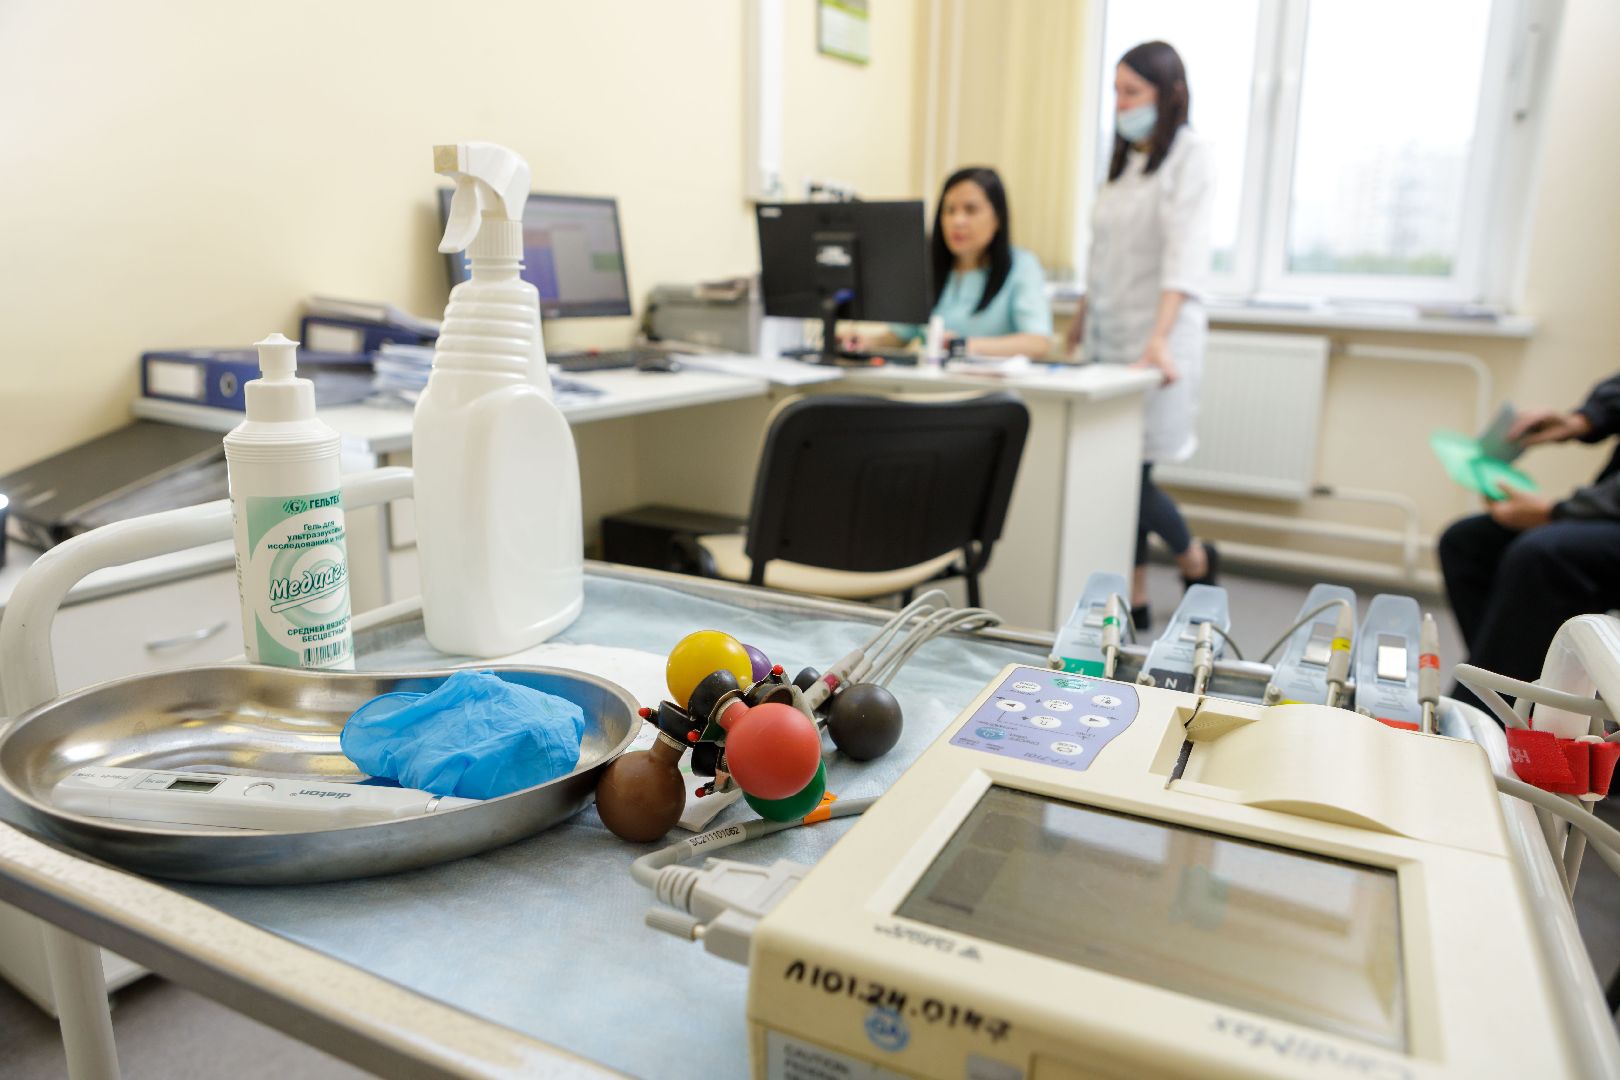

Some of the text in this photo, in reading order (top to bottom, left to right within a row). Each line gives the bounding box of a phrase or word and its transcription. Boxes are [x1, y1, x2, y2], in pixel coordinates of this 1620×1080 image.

[303, 520, 335, 531] Гель для
[267, 538, 329, 550] исследований
[287, 623, 325, 636] СРЕДНЕЙ
[1164, 677, 1178, 689] N
